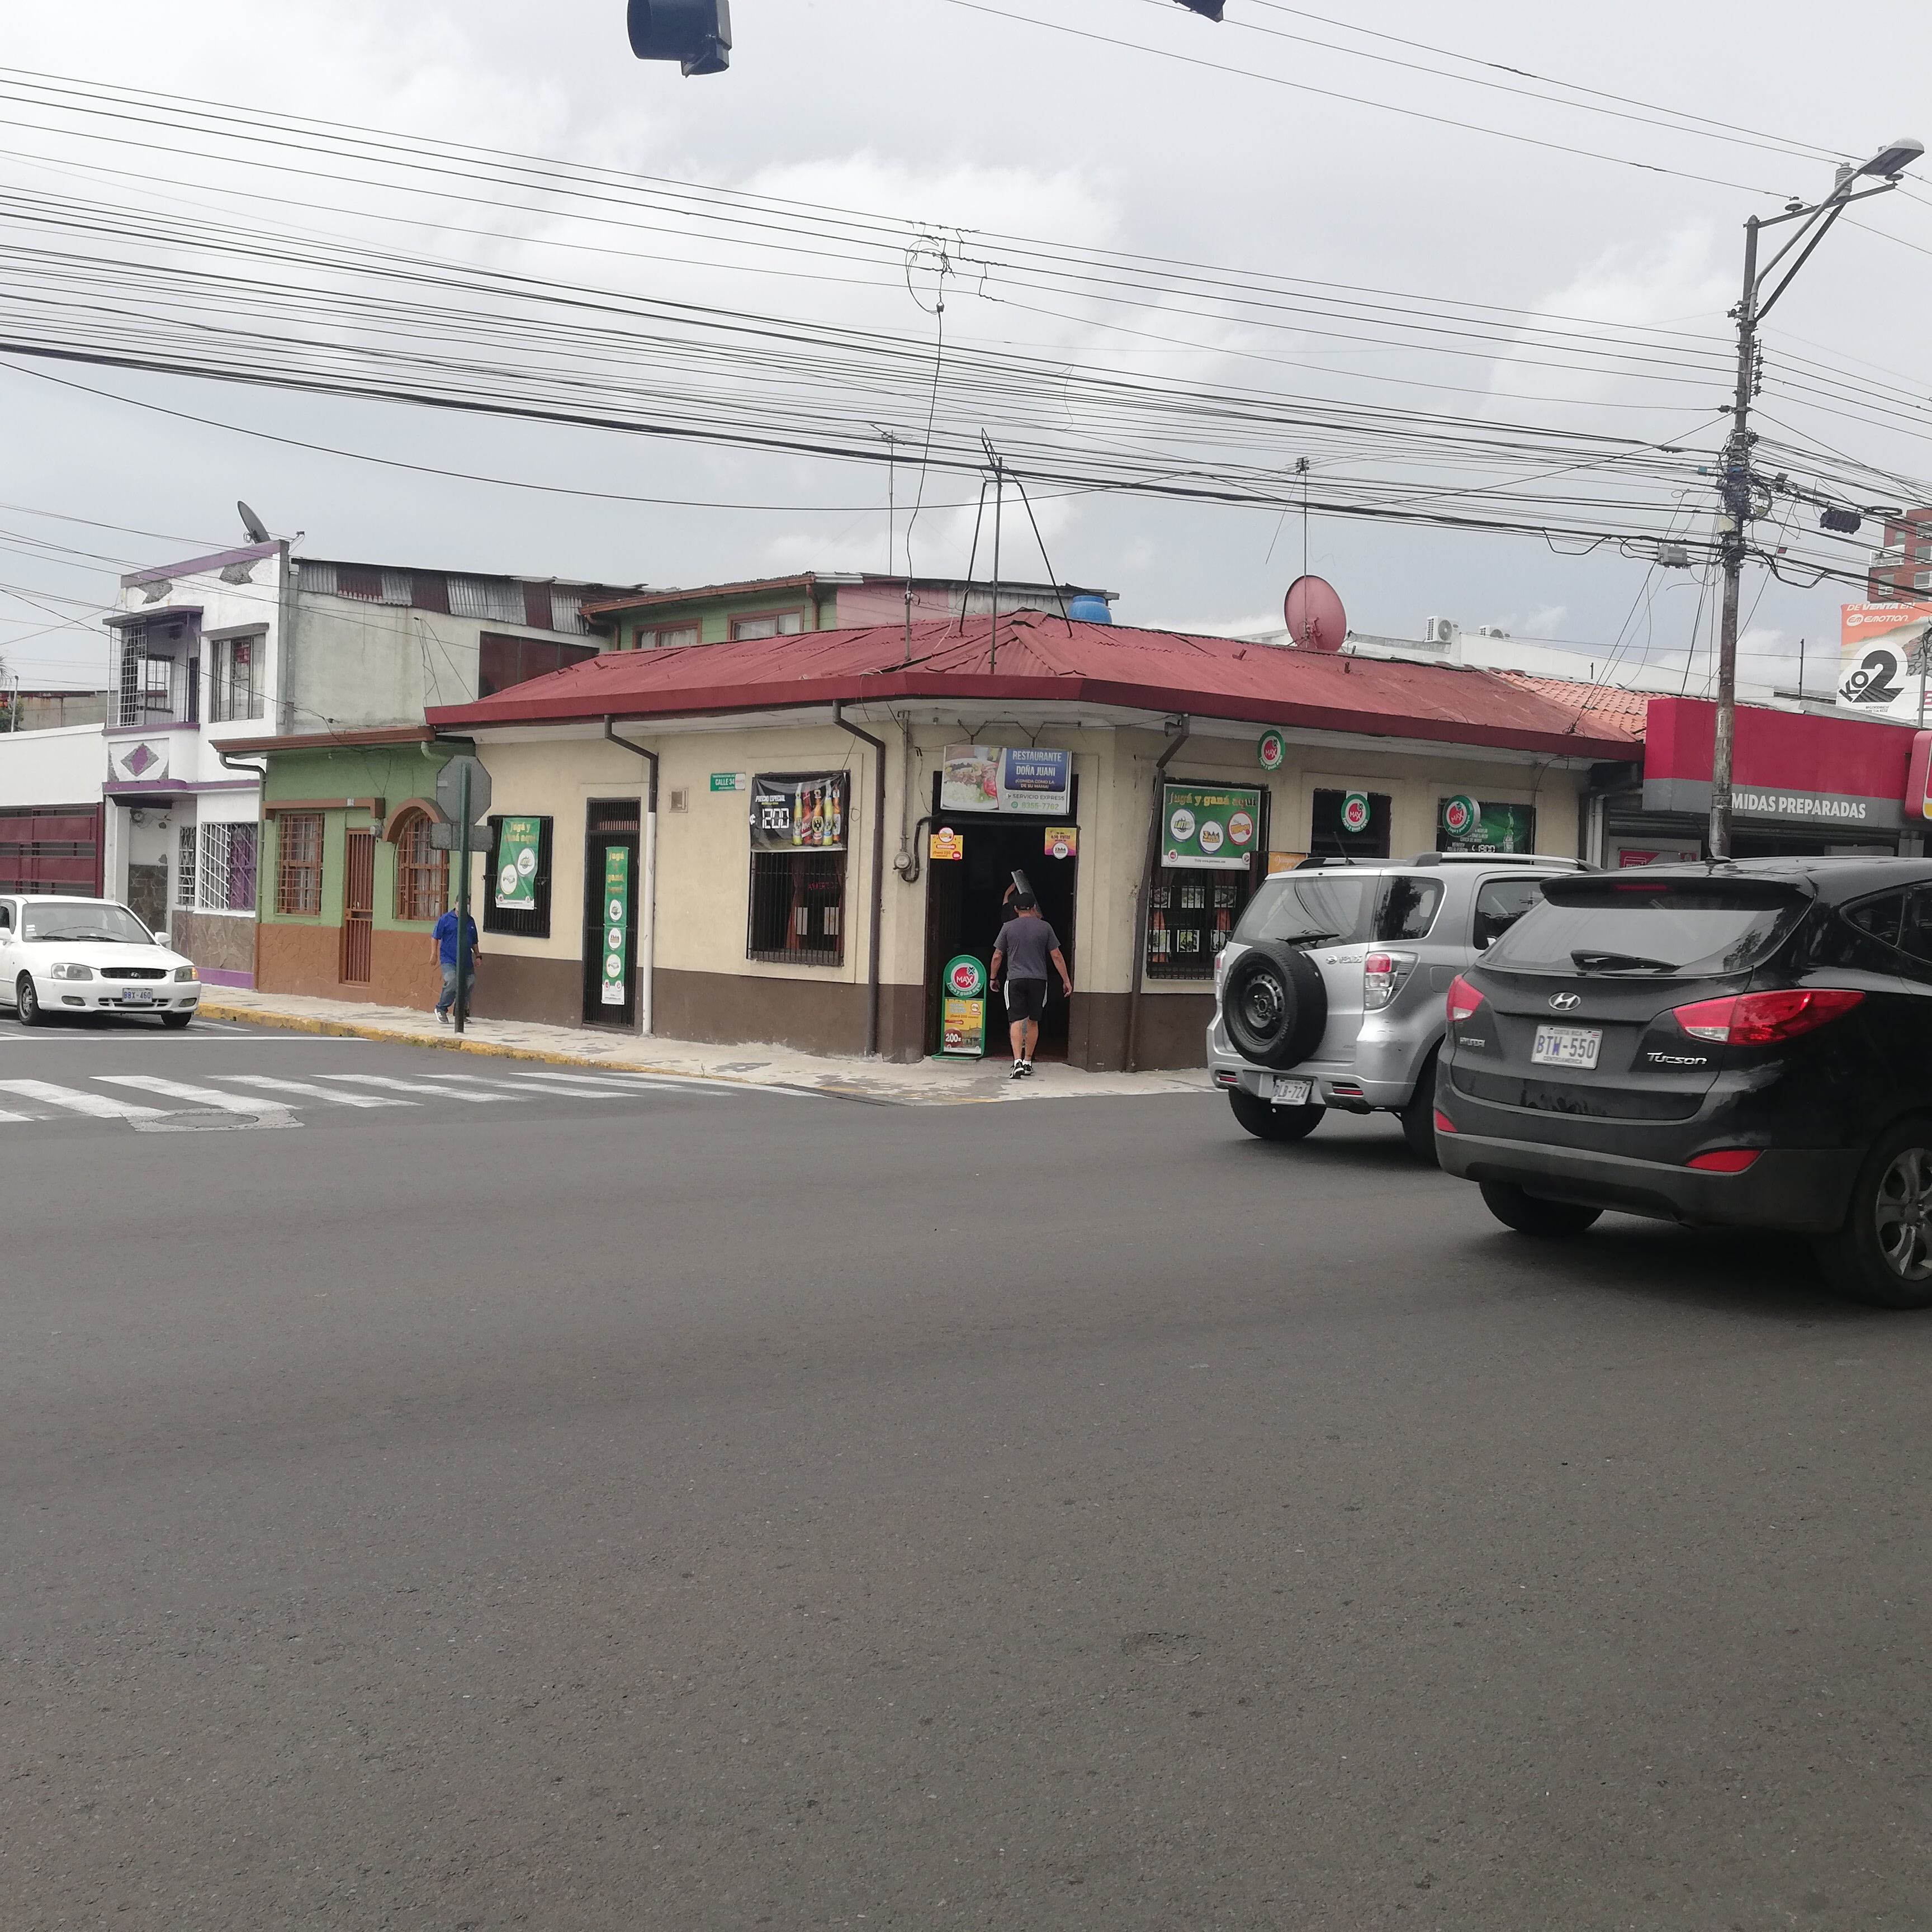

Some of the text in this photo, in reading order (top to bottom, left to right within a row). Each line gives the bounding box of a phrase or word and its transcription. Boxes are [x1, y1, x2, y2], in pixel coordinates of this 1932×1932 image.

[1012, 751, 1062, 762] RESTAURANTE
[1266, 749, 1276, 757] MAX
[1016, 765, 1055, 776] DOÑA JUANI
[1194, 795, 1202, 806] y
[1732, 793, 1866, 818] MIDAS PREPARADAS
[1349, 812, 1361, 820] MAX
[1451, 810, 1464, 823] MAX
[956, 976, 973, 985] MAX
